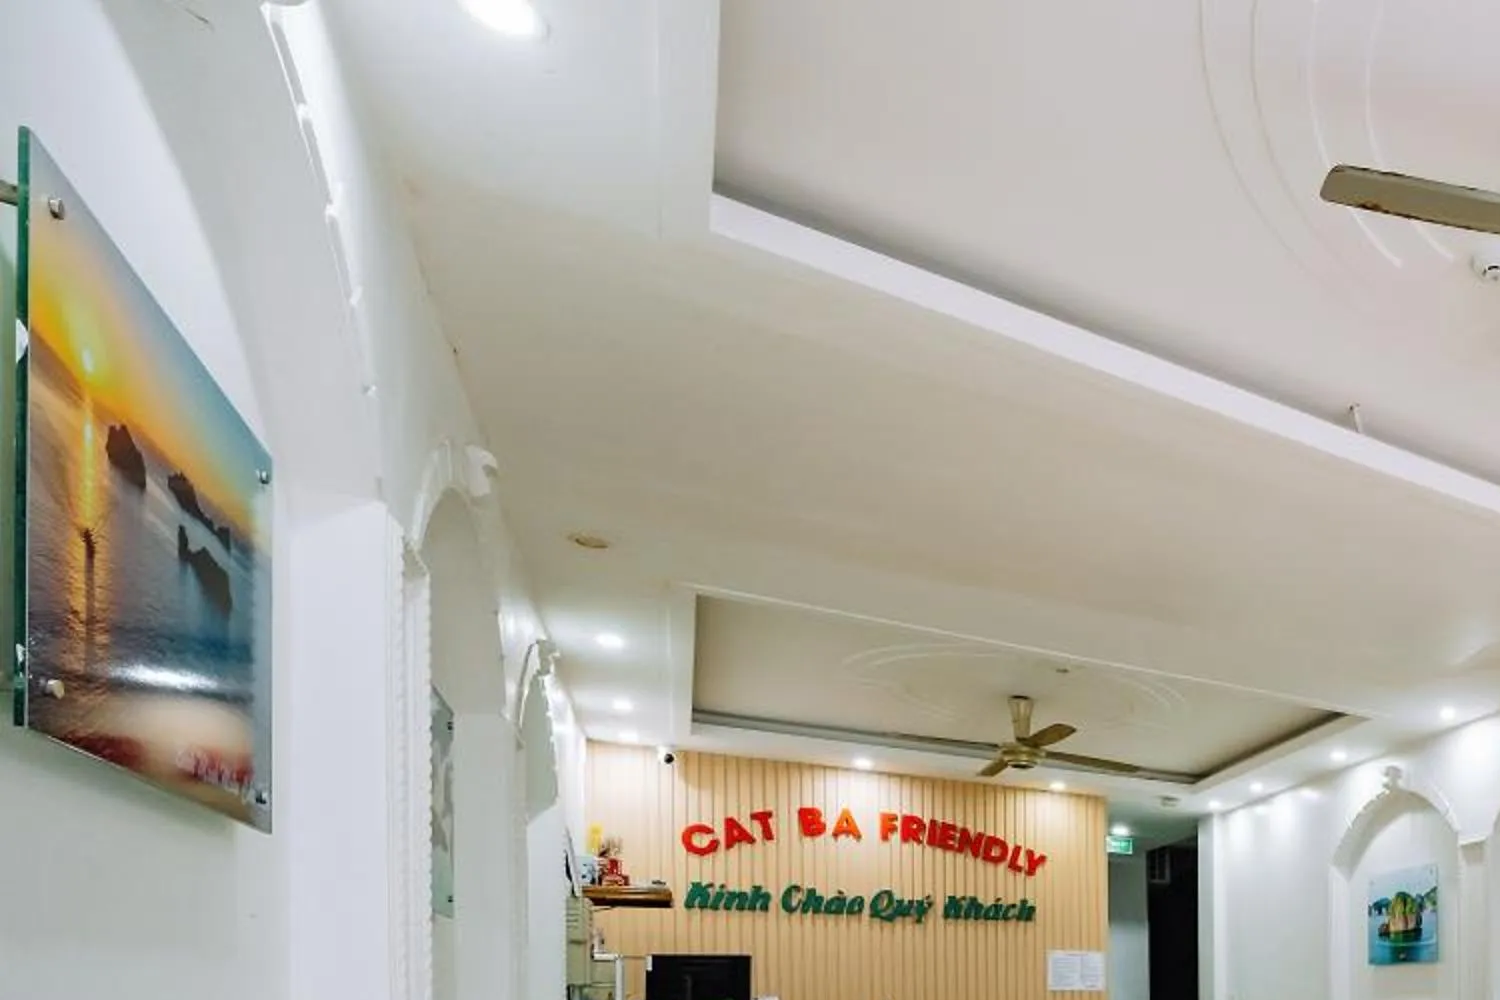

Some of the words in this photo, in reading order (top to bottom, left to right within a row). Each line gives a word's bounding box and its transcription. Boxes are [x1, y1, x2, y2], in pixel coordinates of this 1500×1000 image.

[681, 809, 774, 856] CAT
[798, 806, 863, 842] BA
[880, 812, 1047, 877] FRIENDLY
